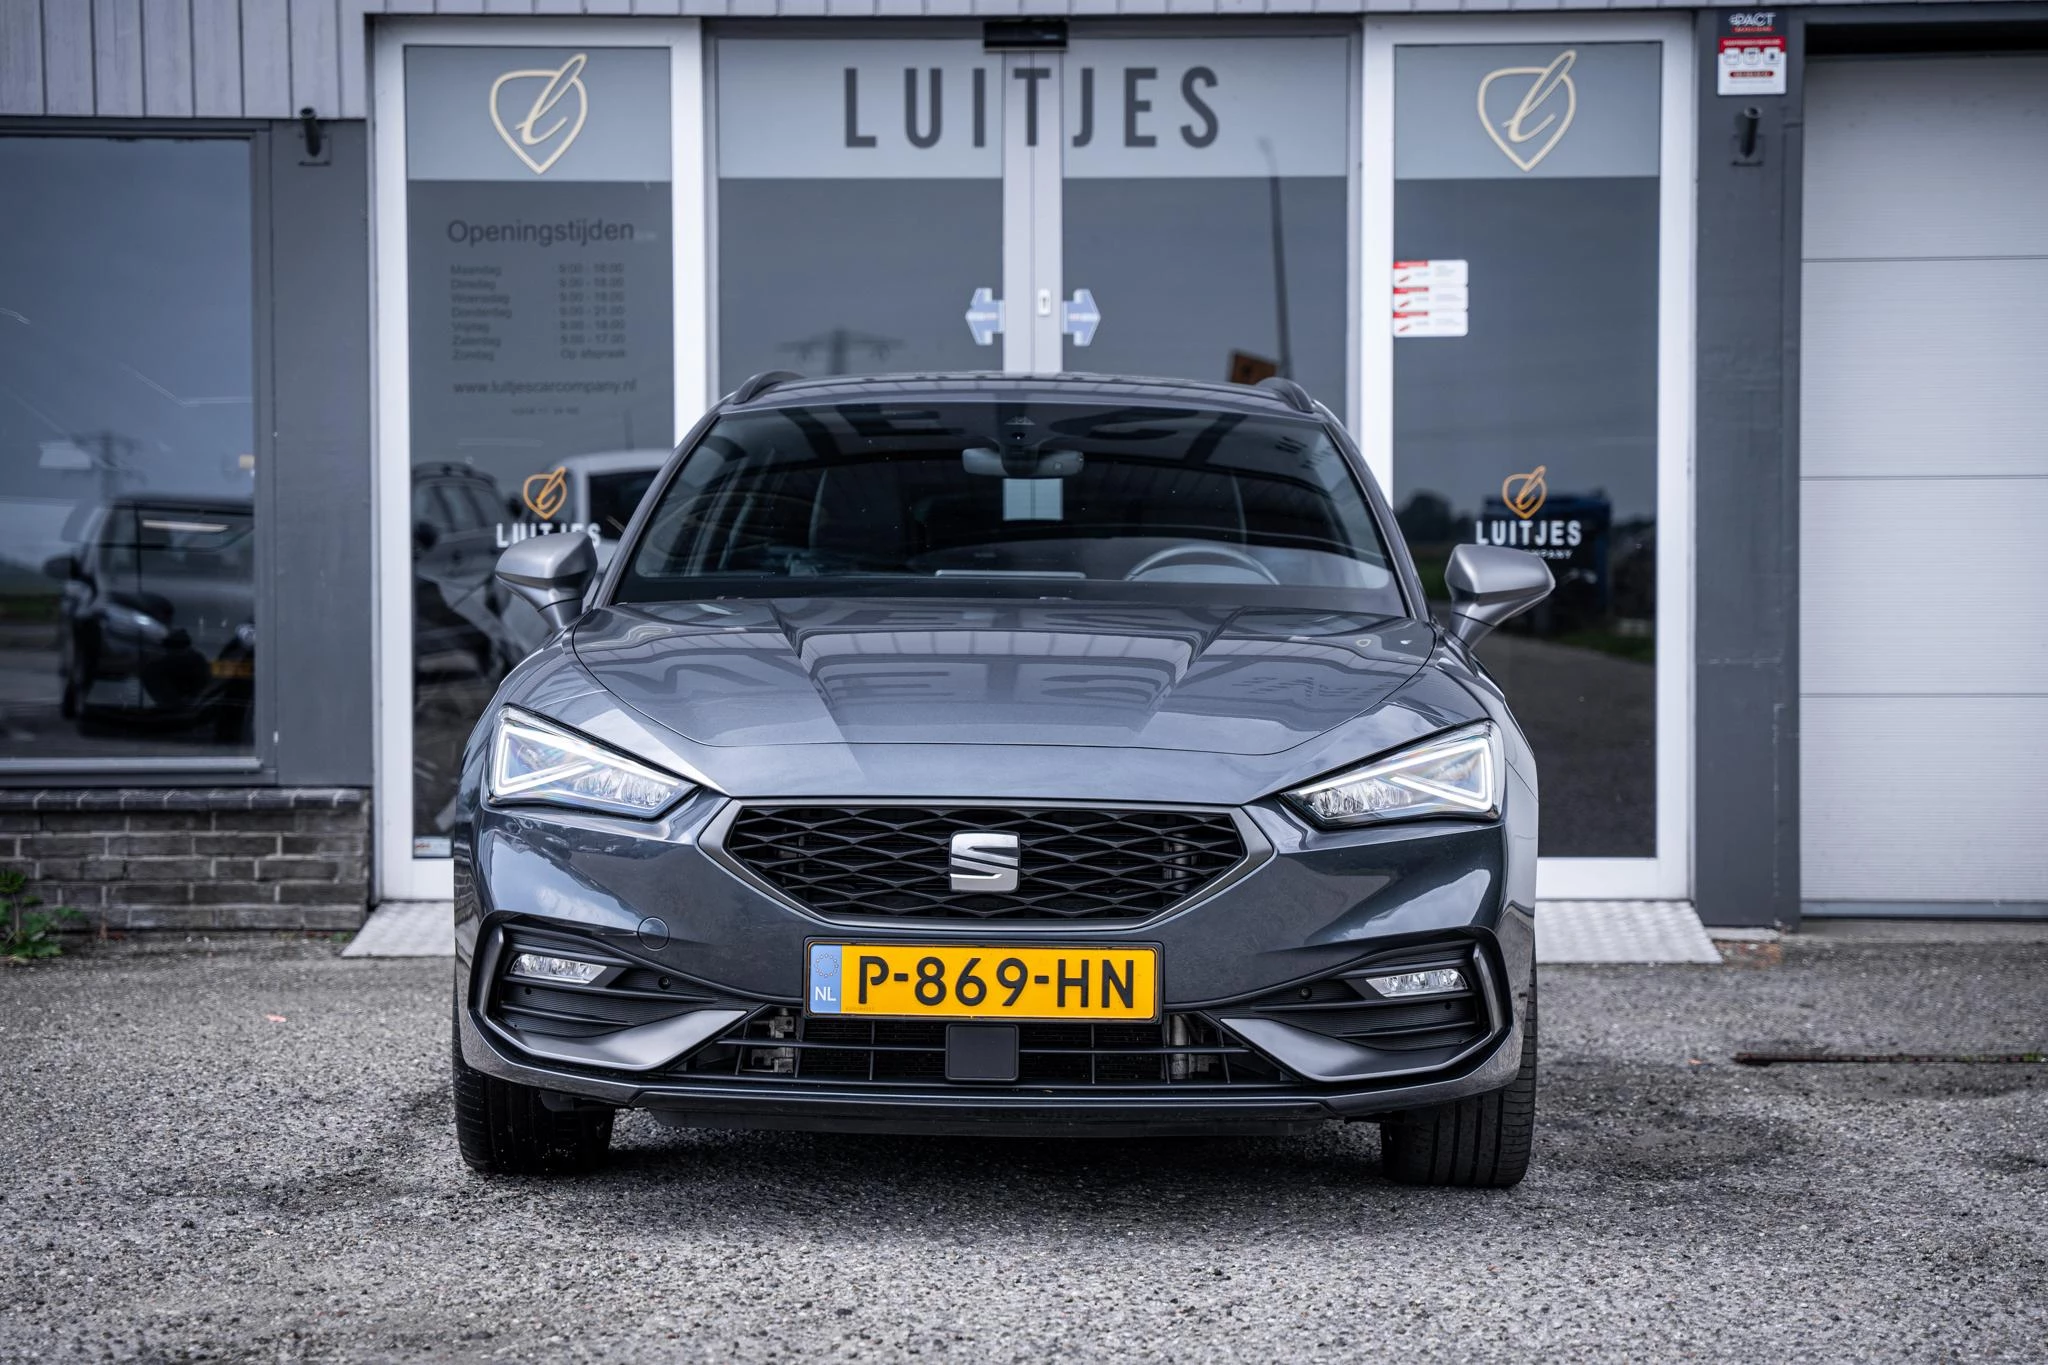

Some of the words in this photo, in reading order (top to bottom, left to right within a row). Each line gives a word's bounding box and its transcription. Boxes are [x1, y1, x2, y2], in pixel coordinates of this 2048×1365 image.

[844, 65, 1219, 149] LUITJES
[447, 219, 635, 247] Openingstijden
[1475, 520, 1582, 546] LUITJES
[814, 986, 837, 1002] NL
[857, 954, 1135, 1009] P-869-HN
